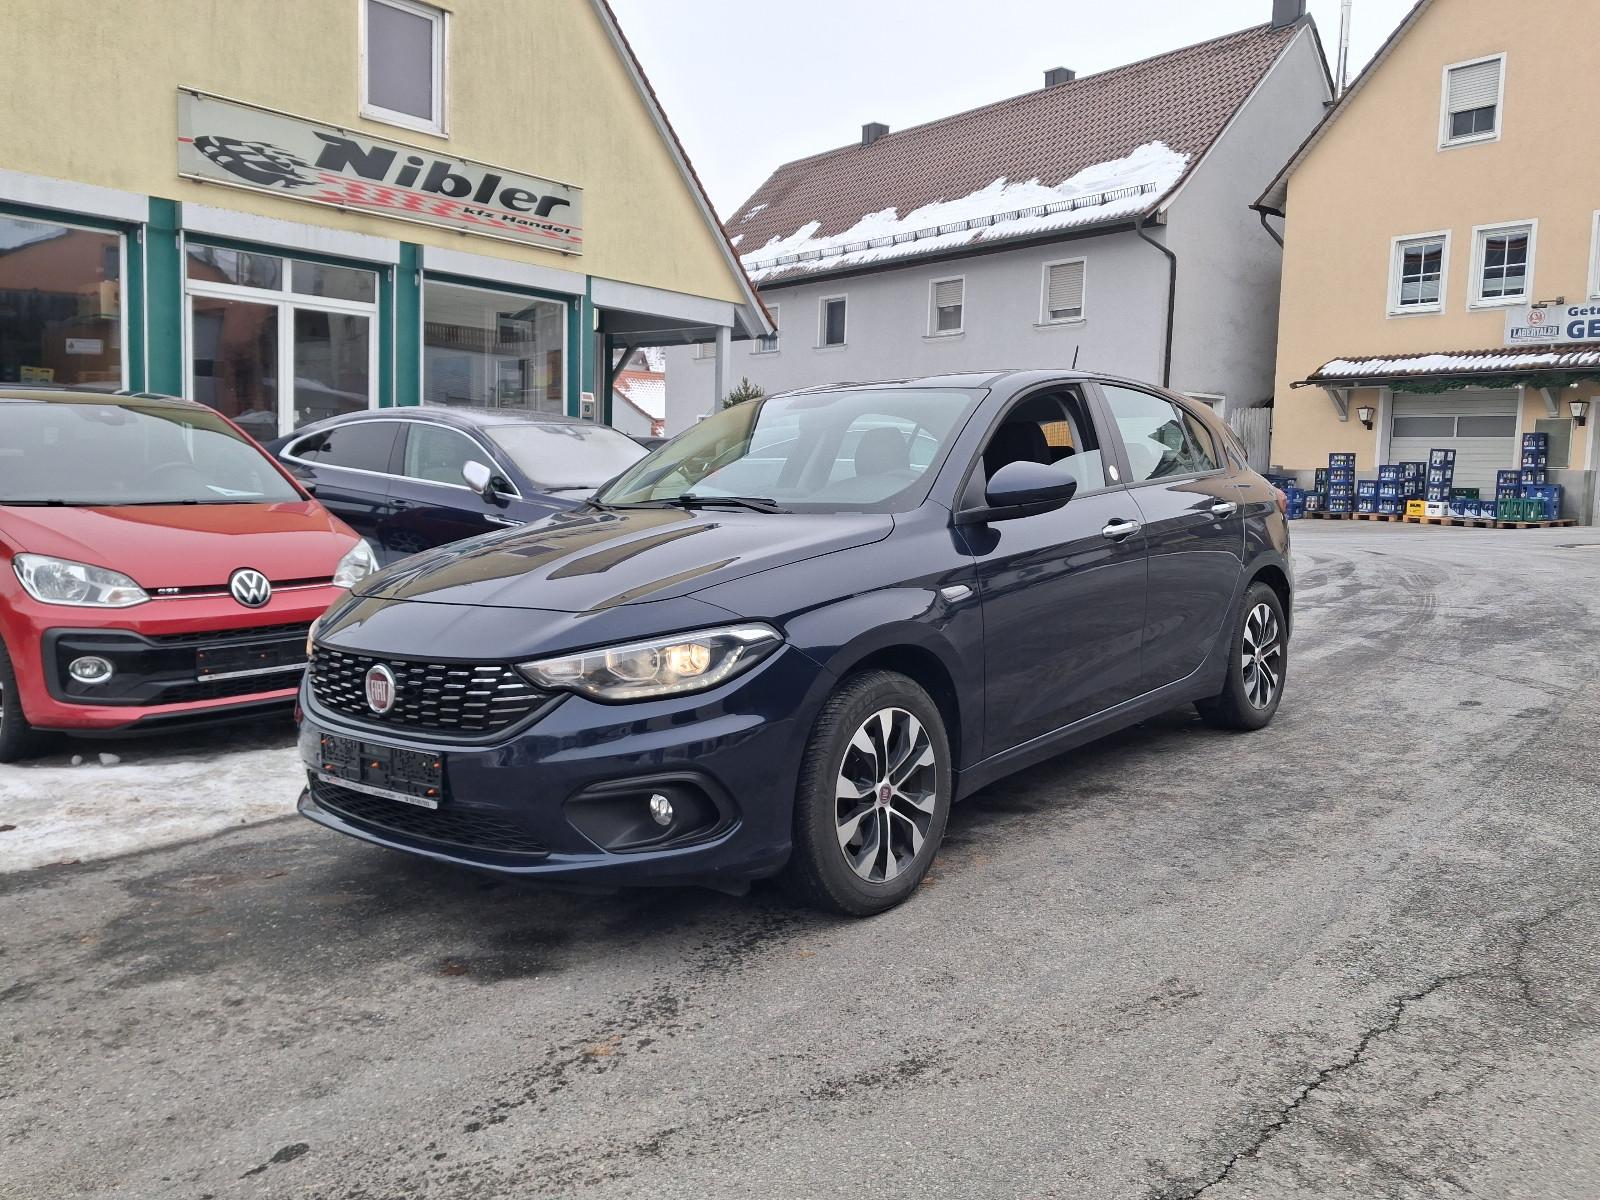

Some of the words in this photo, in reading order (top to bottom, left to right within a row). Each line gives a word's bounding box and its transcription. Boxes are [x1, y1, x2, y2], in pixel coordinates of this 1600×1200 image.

[312, 131, 570, 218] Nibler
[501, 214, 571, 234] Handel
[1512, 326, 1558, 338] LABERTALER
[370, 679, 388, 702] FIAT
